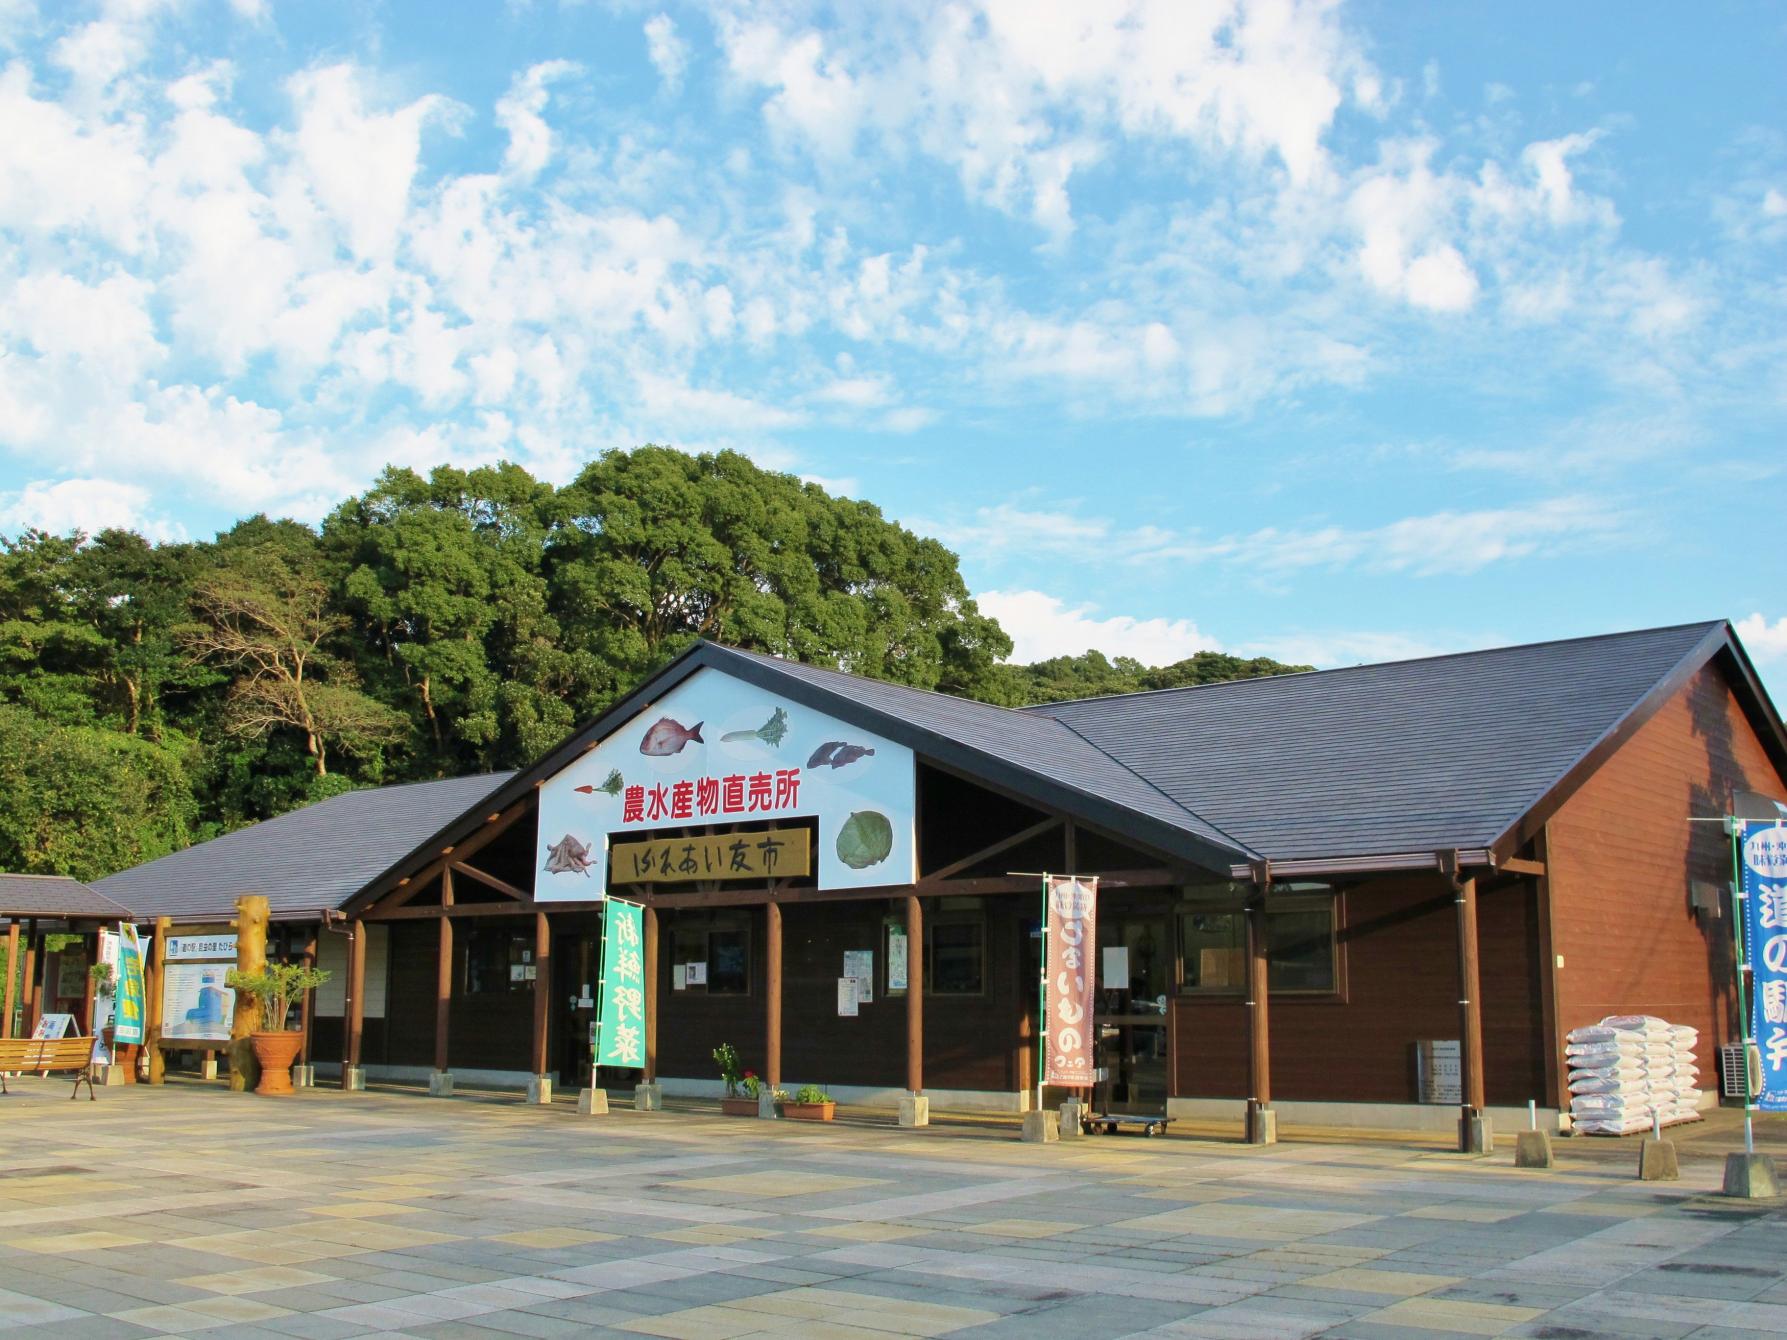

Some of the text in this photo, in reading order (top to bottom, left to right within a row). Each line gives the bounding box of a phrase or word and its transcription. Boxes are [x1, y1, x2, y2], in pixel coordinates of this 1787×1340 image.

[623, 768, 802, 824] 農水産物直売所
